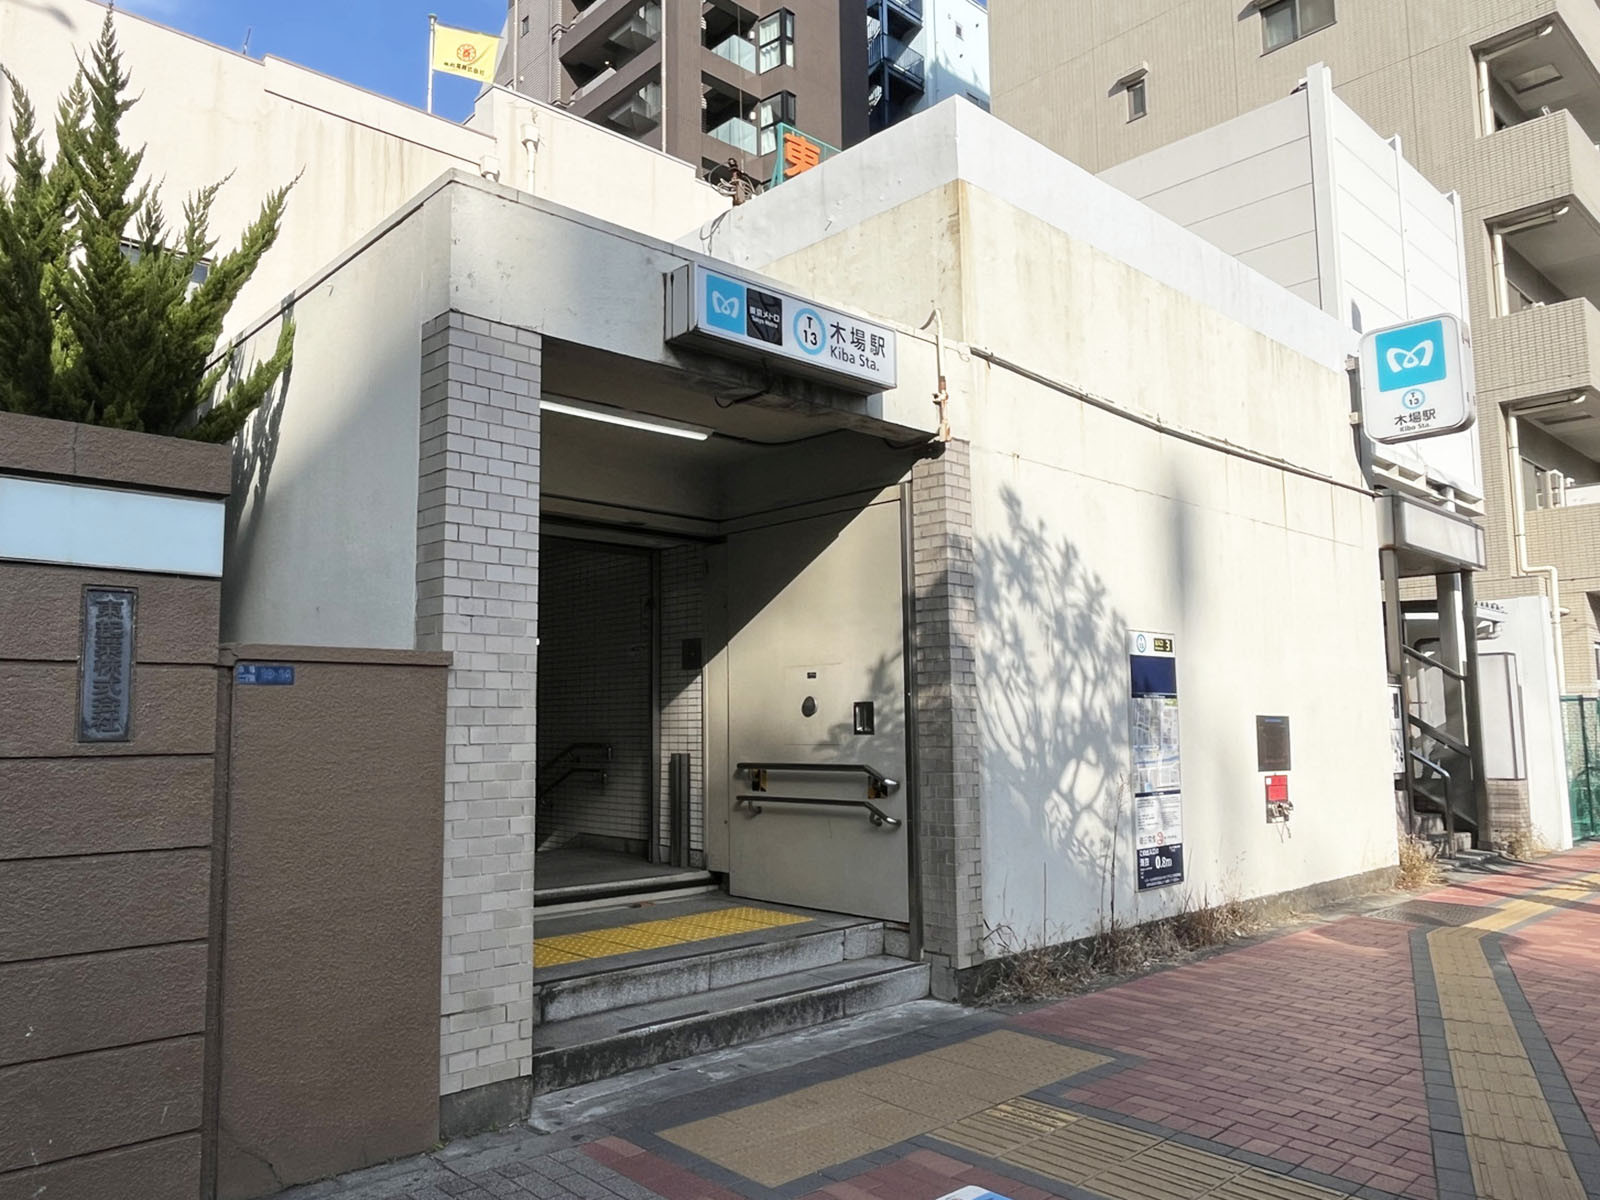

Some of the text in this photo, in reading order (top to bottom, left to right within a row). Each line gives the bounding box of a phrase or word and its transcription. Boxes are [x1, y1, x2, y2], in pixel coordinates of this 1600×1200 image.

[750, 305, 780, 323] 東京メトロ
[806, 315, 813, 329] T
[803, 329, 818, 346] 13
[830, 321, 886, 358] 木場駅
[830, 345, 880, 372] Kiba Sta.
[1394, 408, 1436, 426] 木場駅
[1165, 639, 1171, 652] 3
